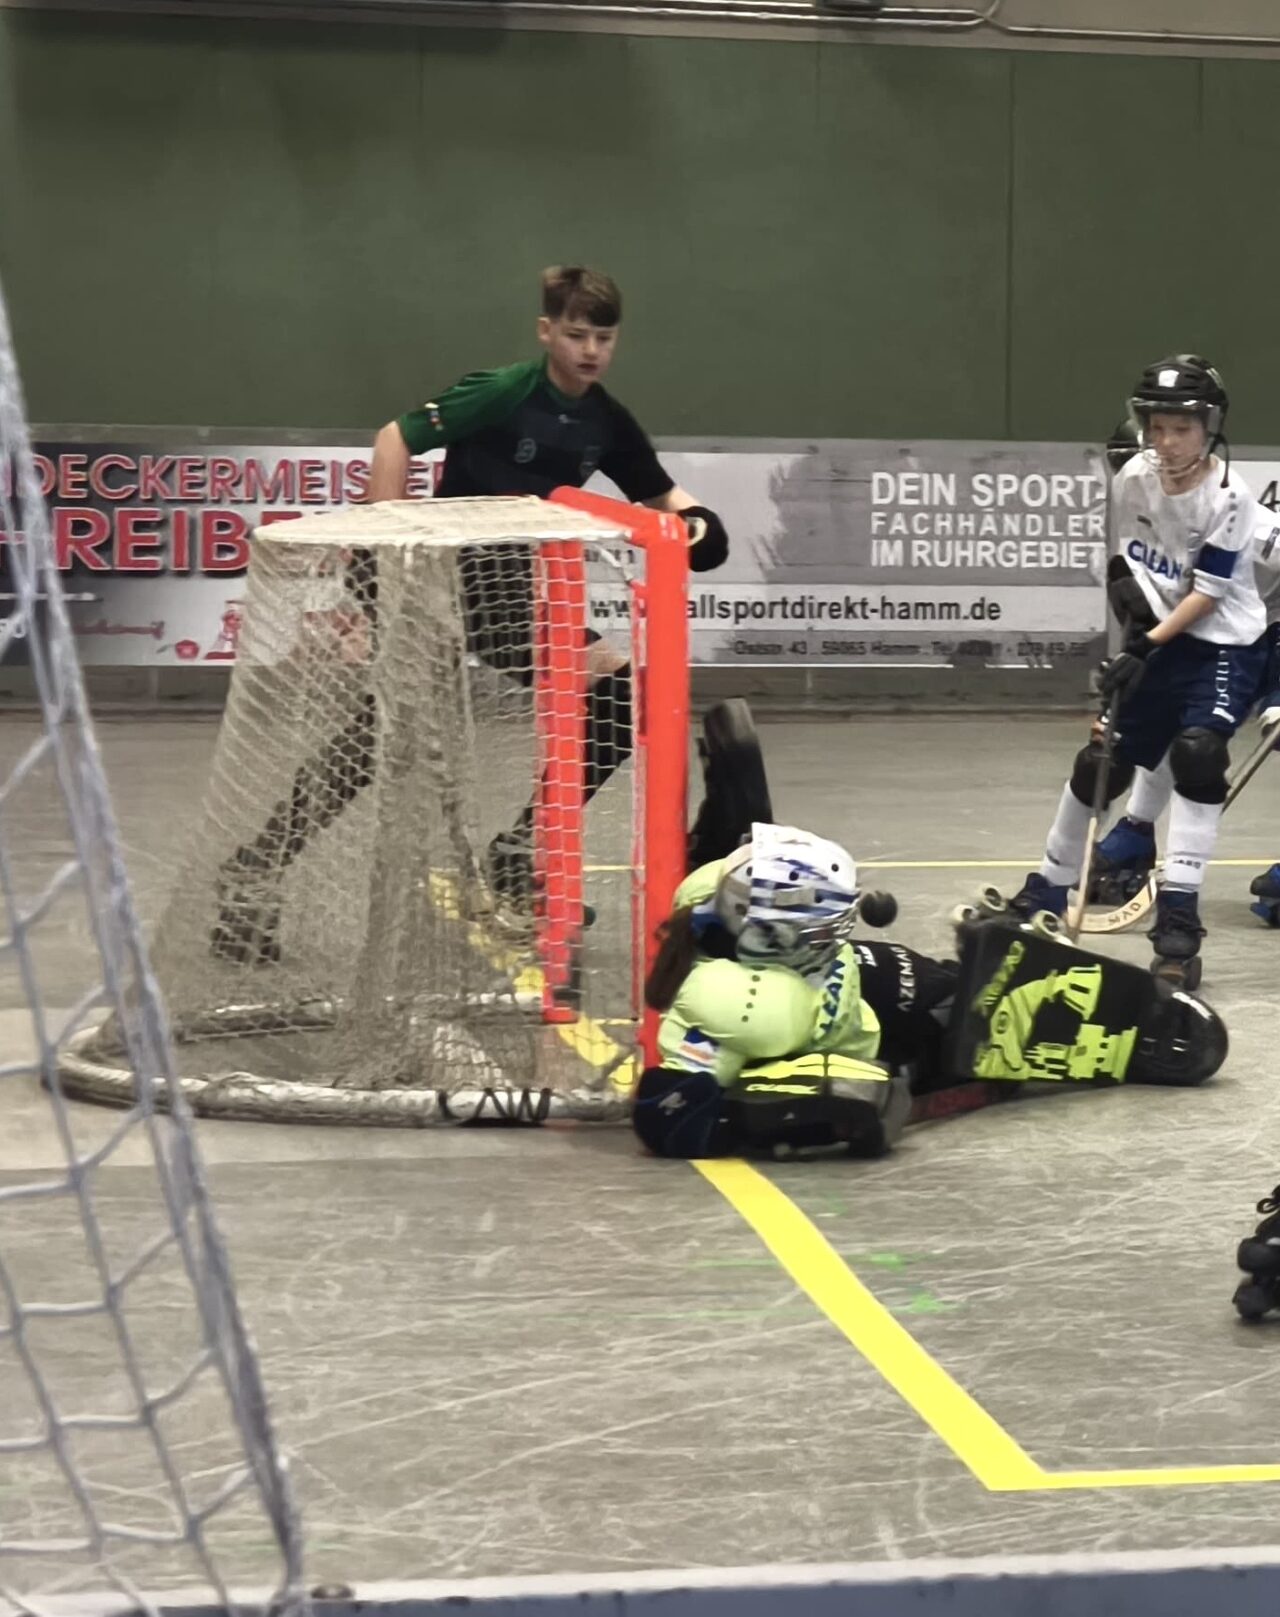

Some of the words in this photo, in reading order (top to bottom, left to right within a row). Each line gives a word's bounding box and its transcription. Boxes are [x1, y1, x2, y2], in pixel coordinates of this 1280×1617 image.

[871, 471, 956, 506] DEIN
[971, 473, 1106, 508] SPORT-
[870, 508, 1106, 537] FACHHÄNDLER
[871, 539, 904, 567] IM
[911, 540, 1107, 569] RUHRGEBIET
